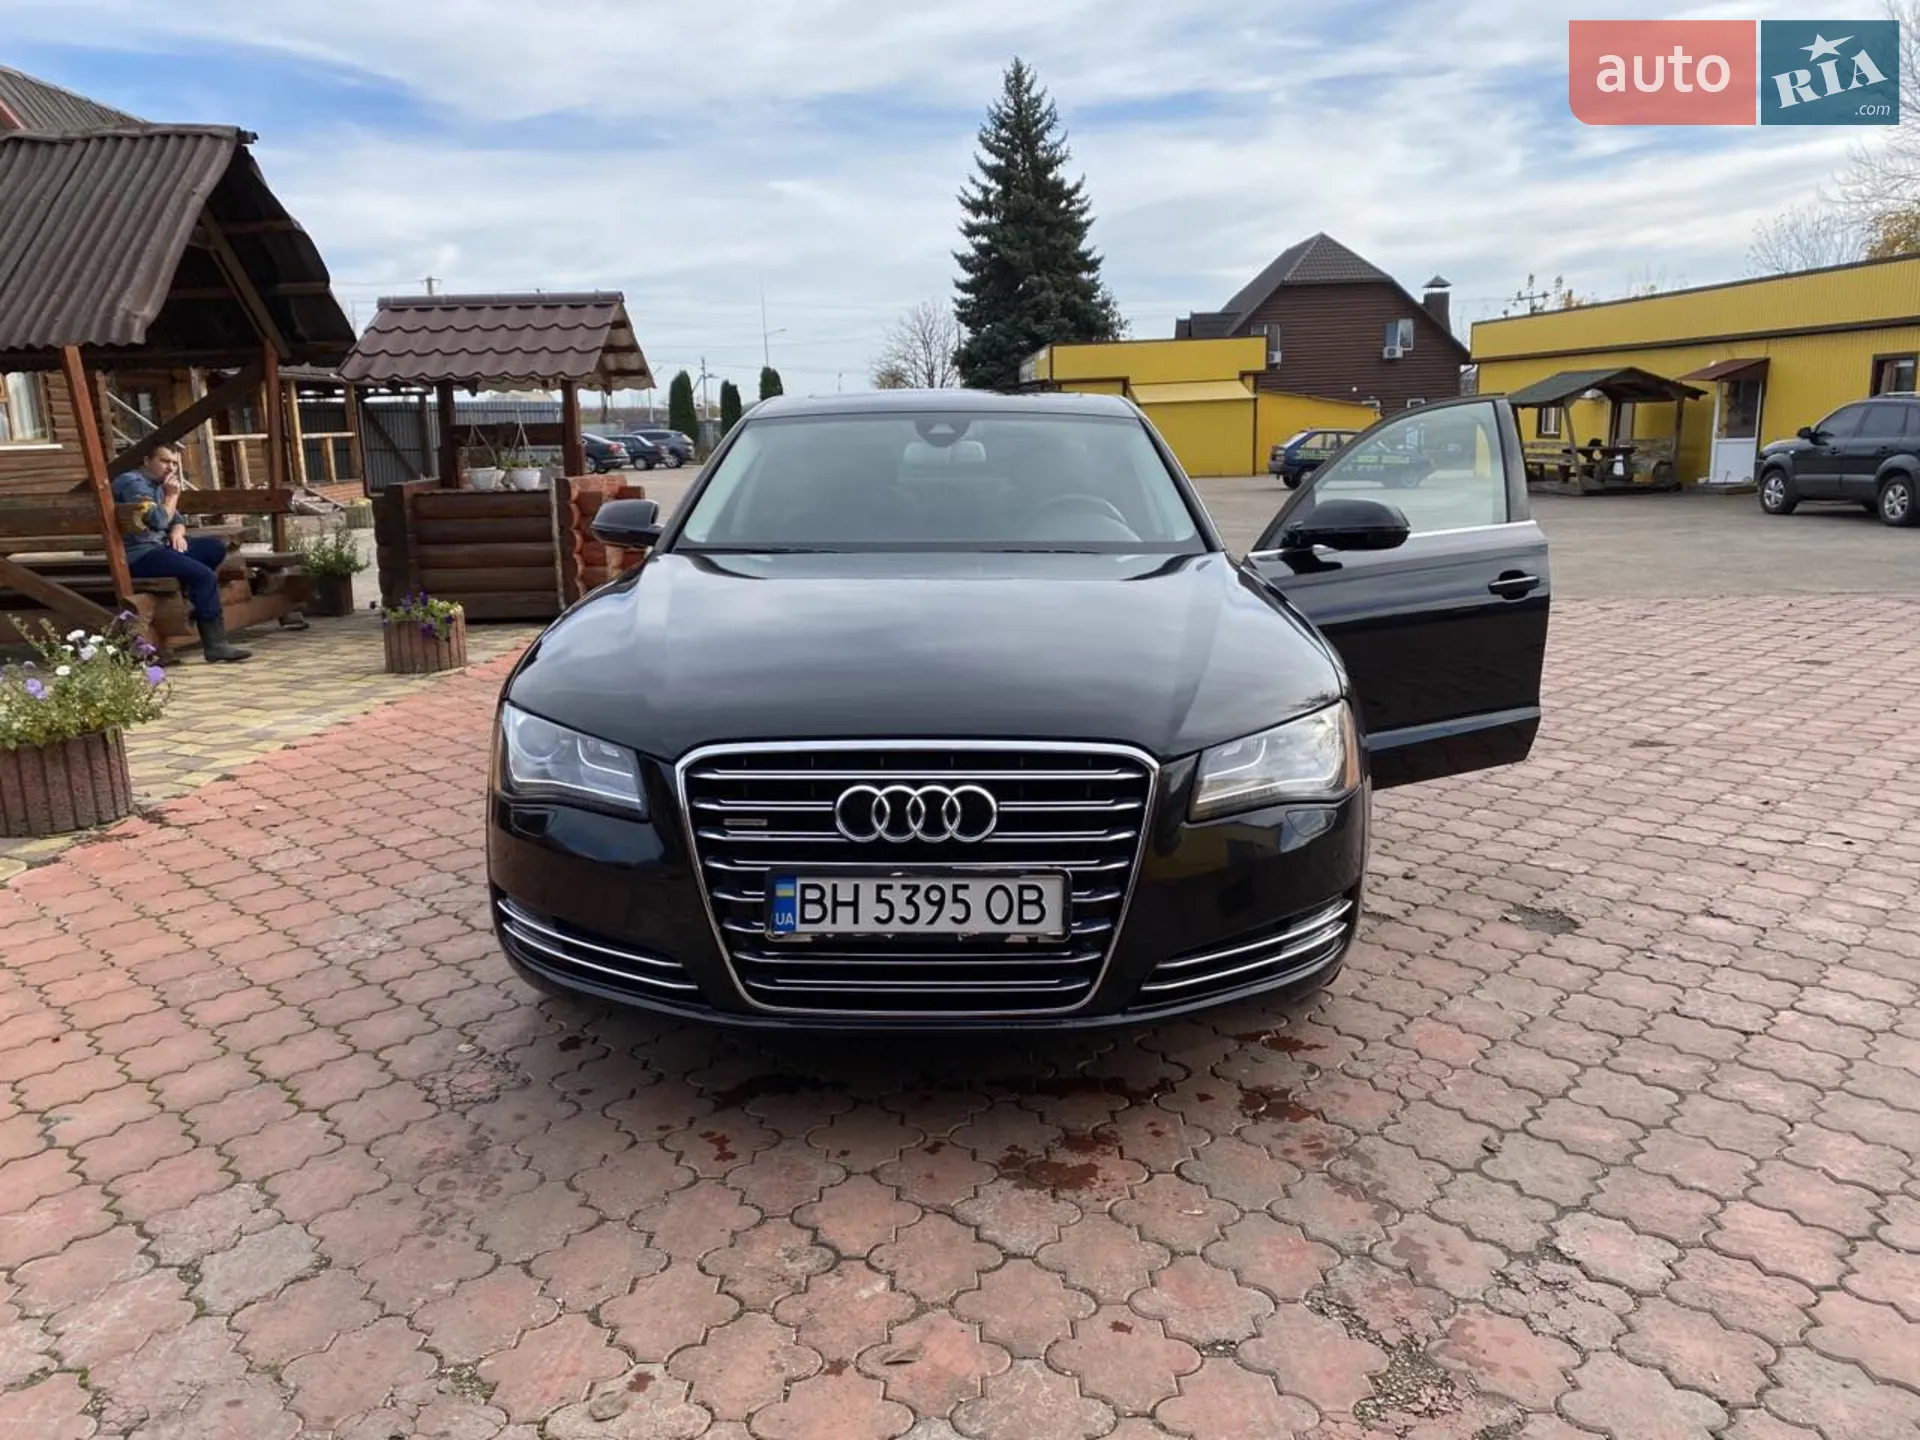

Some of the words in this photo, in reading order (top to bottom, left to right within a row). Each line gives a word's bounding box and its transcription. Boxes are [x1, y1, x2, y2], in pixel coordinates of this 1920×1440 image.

[799, 883, 860, 925] BH
[873, 883, 972, 925] 5395
[984, 883, 1047, 925] OB
[775, 911, 795, 926] UA
